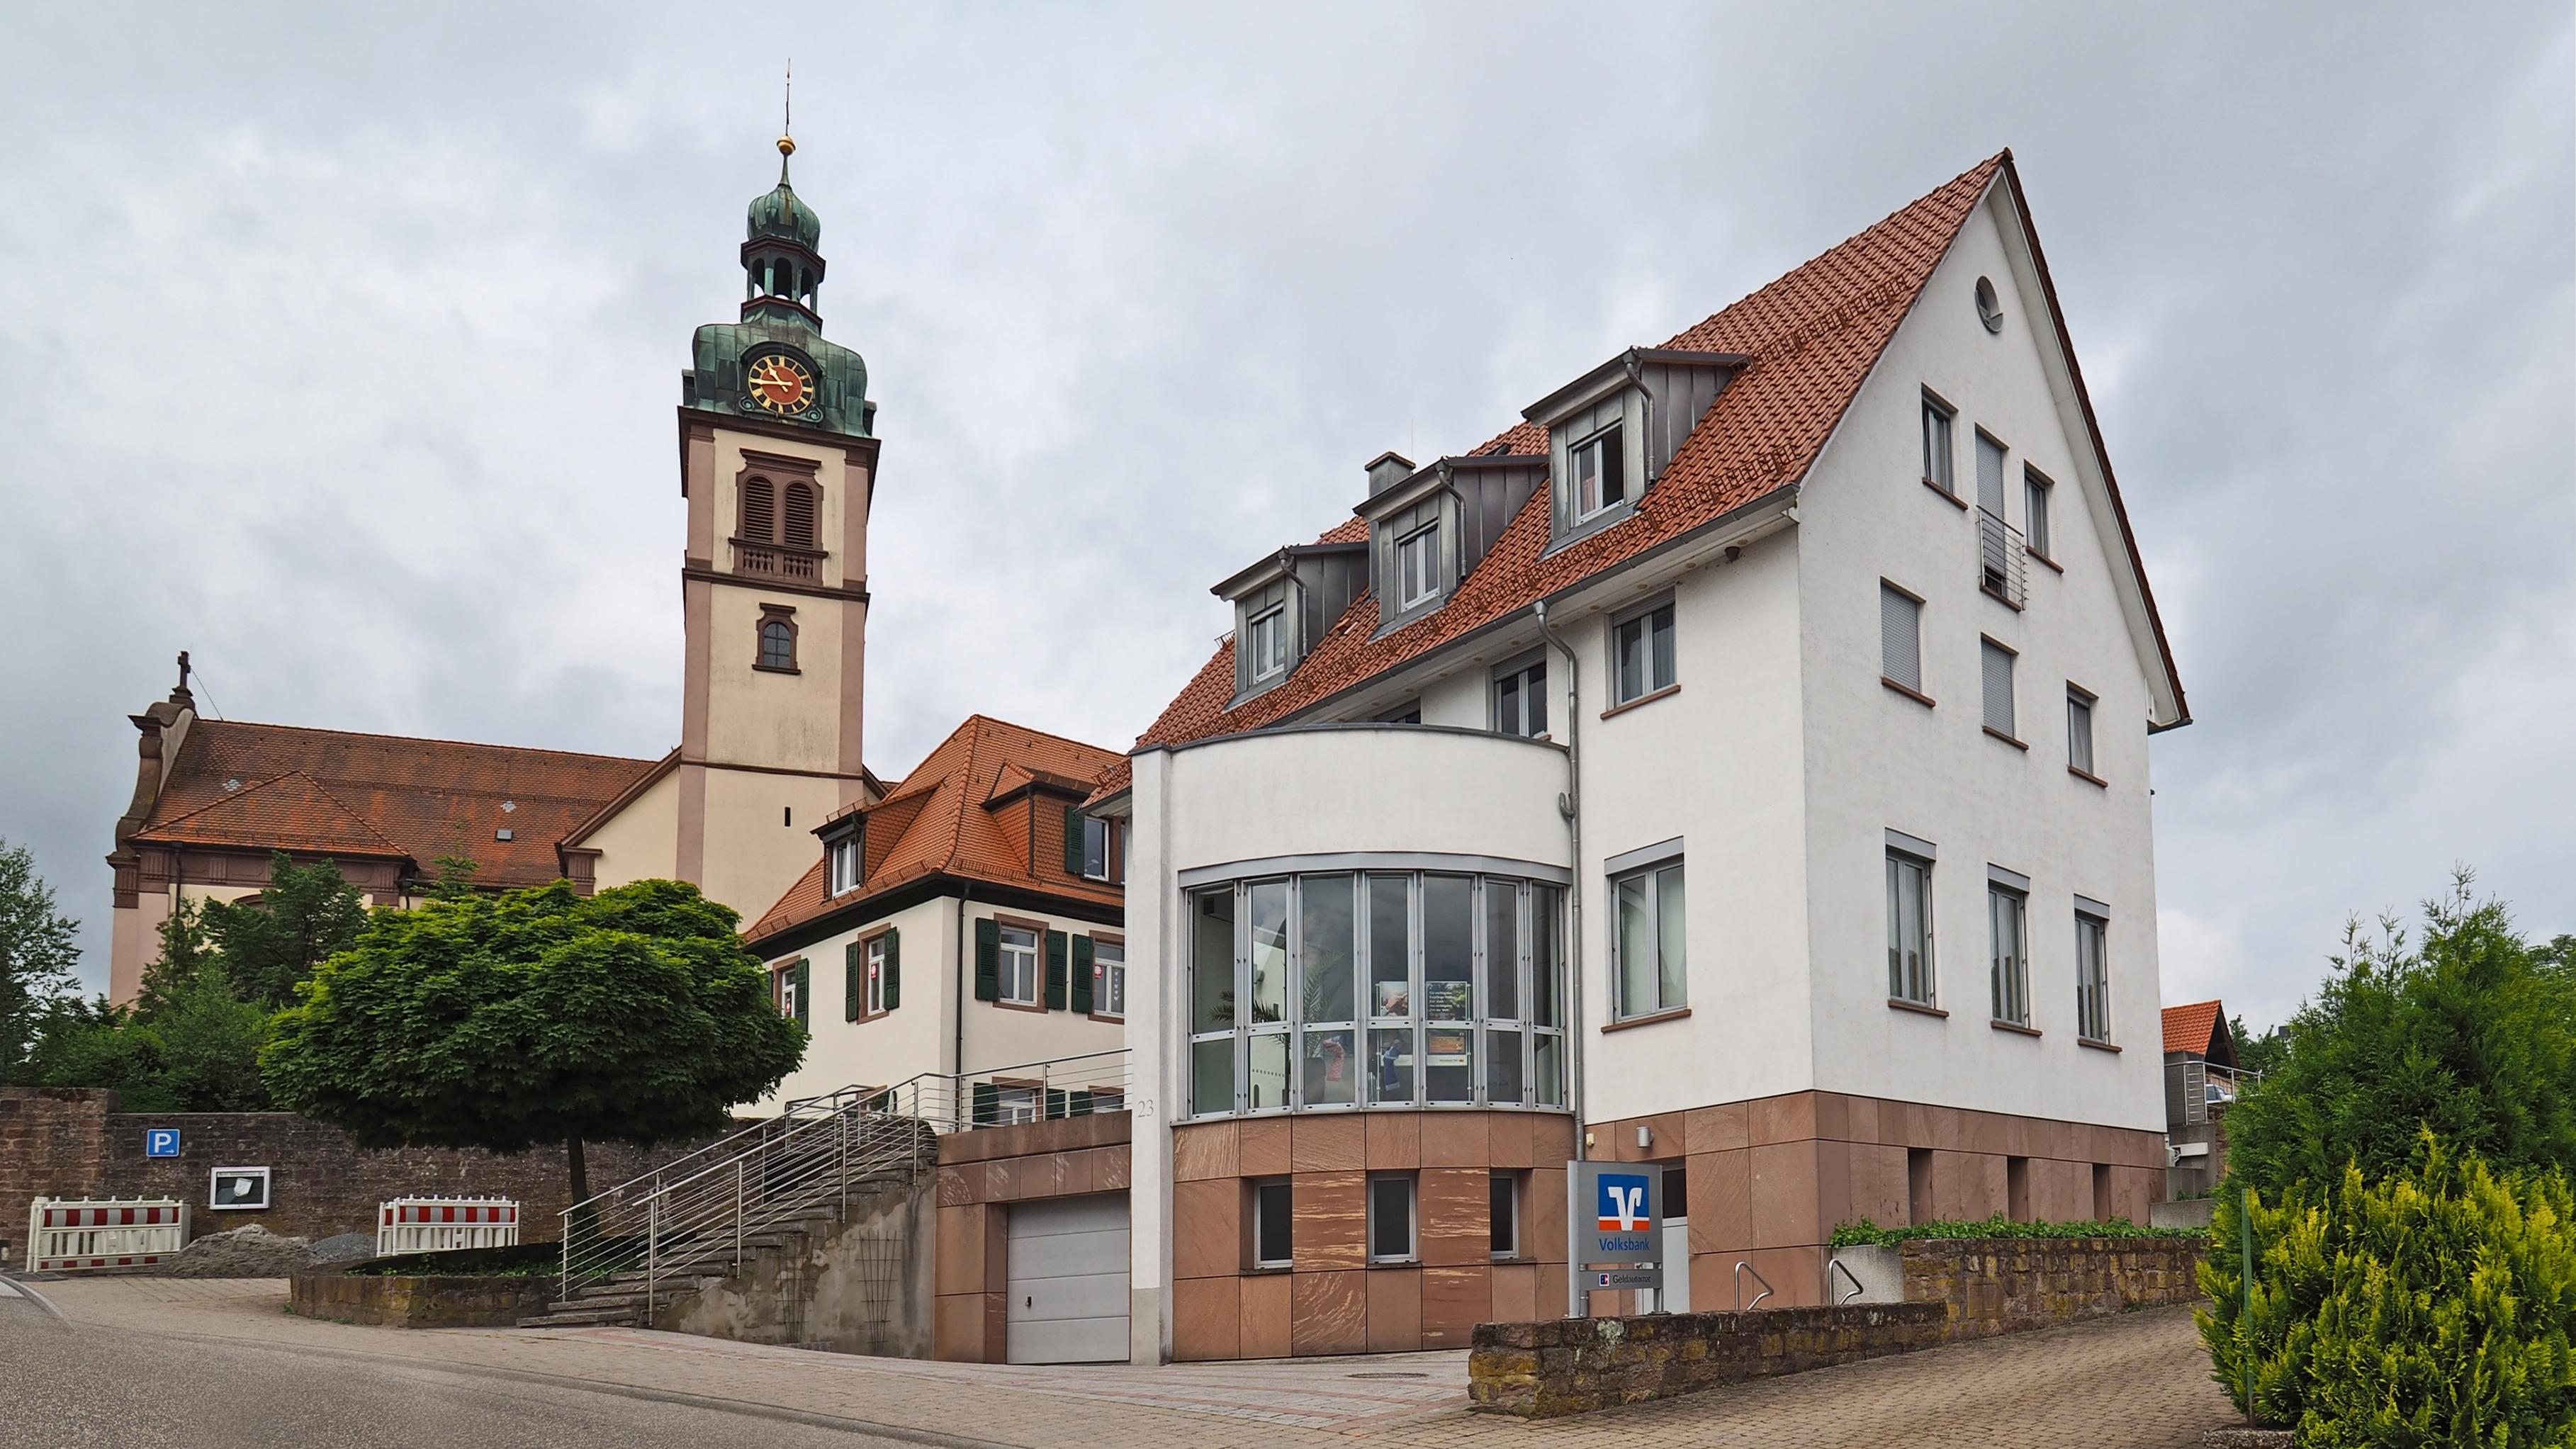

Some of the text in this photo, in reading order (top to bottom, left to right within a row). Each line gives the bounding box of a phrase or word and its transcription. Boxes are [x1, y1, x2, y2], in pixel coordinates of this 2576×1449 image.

[1137, 1099, 1154, 1117] 23
[154, 1133, 172, 1154] P
[1599, 1237, 1650, 1251] Volksbank
